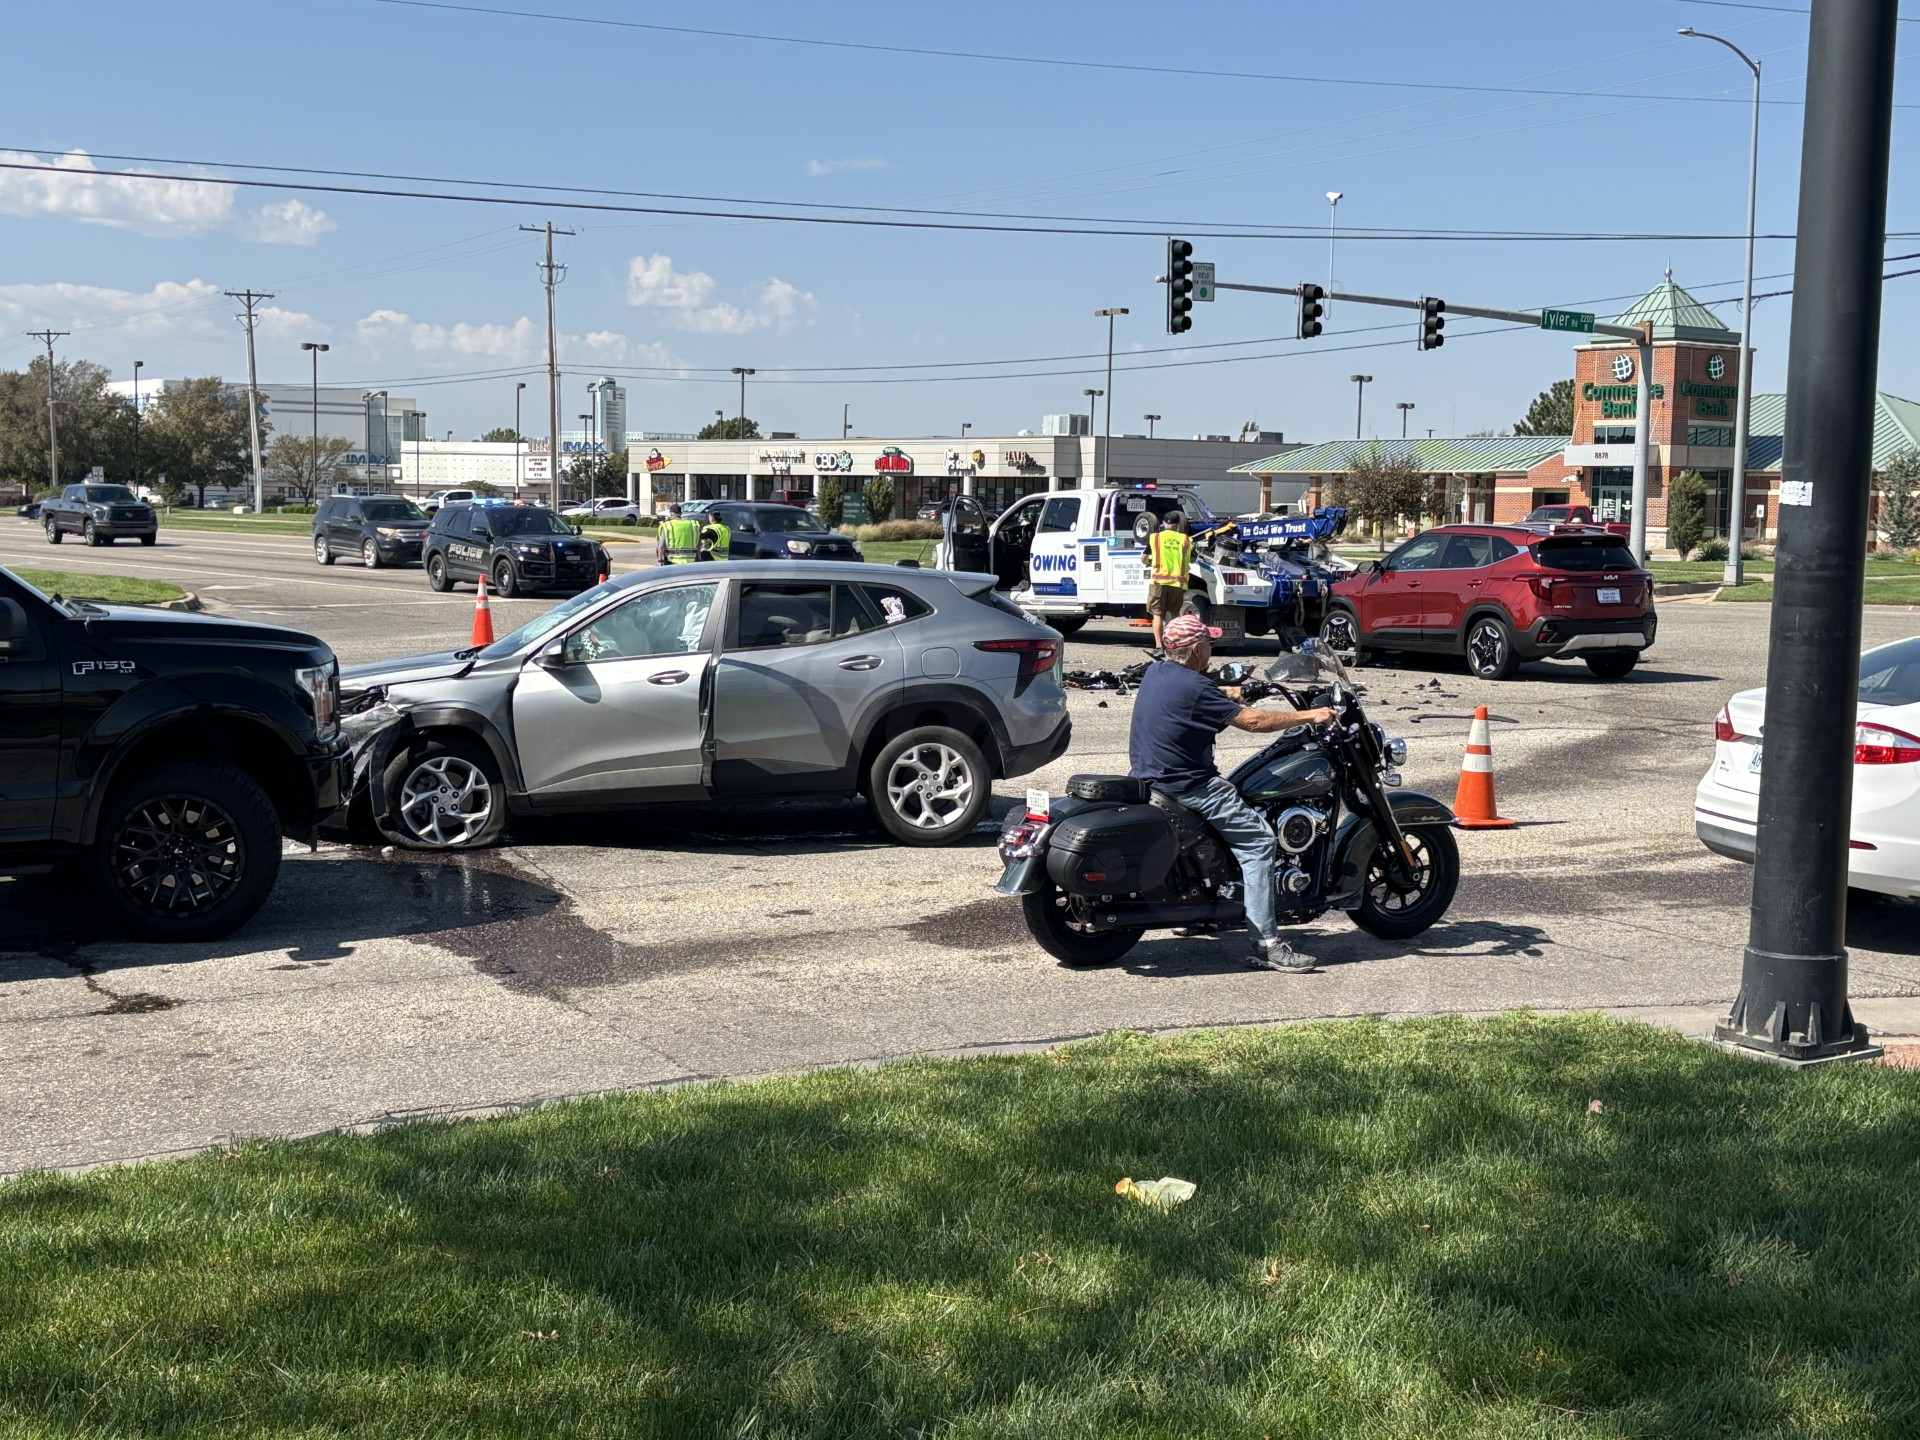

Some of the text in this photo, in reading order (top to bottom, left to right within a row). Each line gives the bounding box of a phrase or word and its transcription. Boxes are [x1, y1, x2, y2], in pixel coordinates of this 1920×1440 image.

[1544, 310, 1569, 330] Tyler
[1581, 314, 1593, 323] 2200
[1697, 400, 1729, 416] Bank
[563, 441, 605, 452] IMAX
[815, 453, 838, 470] CBD
[1243, 523, 1306, 536] In God We Trust
[449, 543, 484, 560] POLICE
[1031, 553, 1077, 571] OWING
